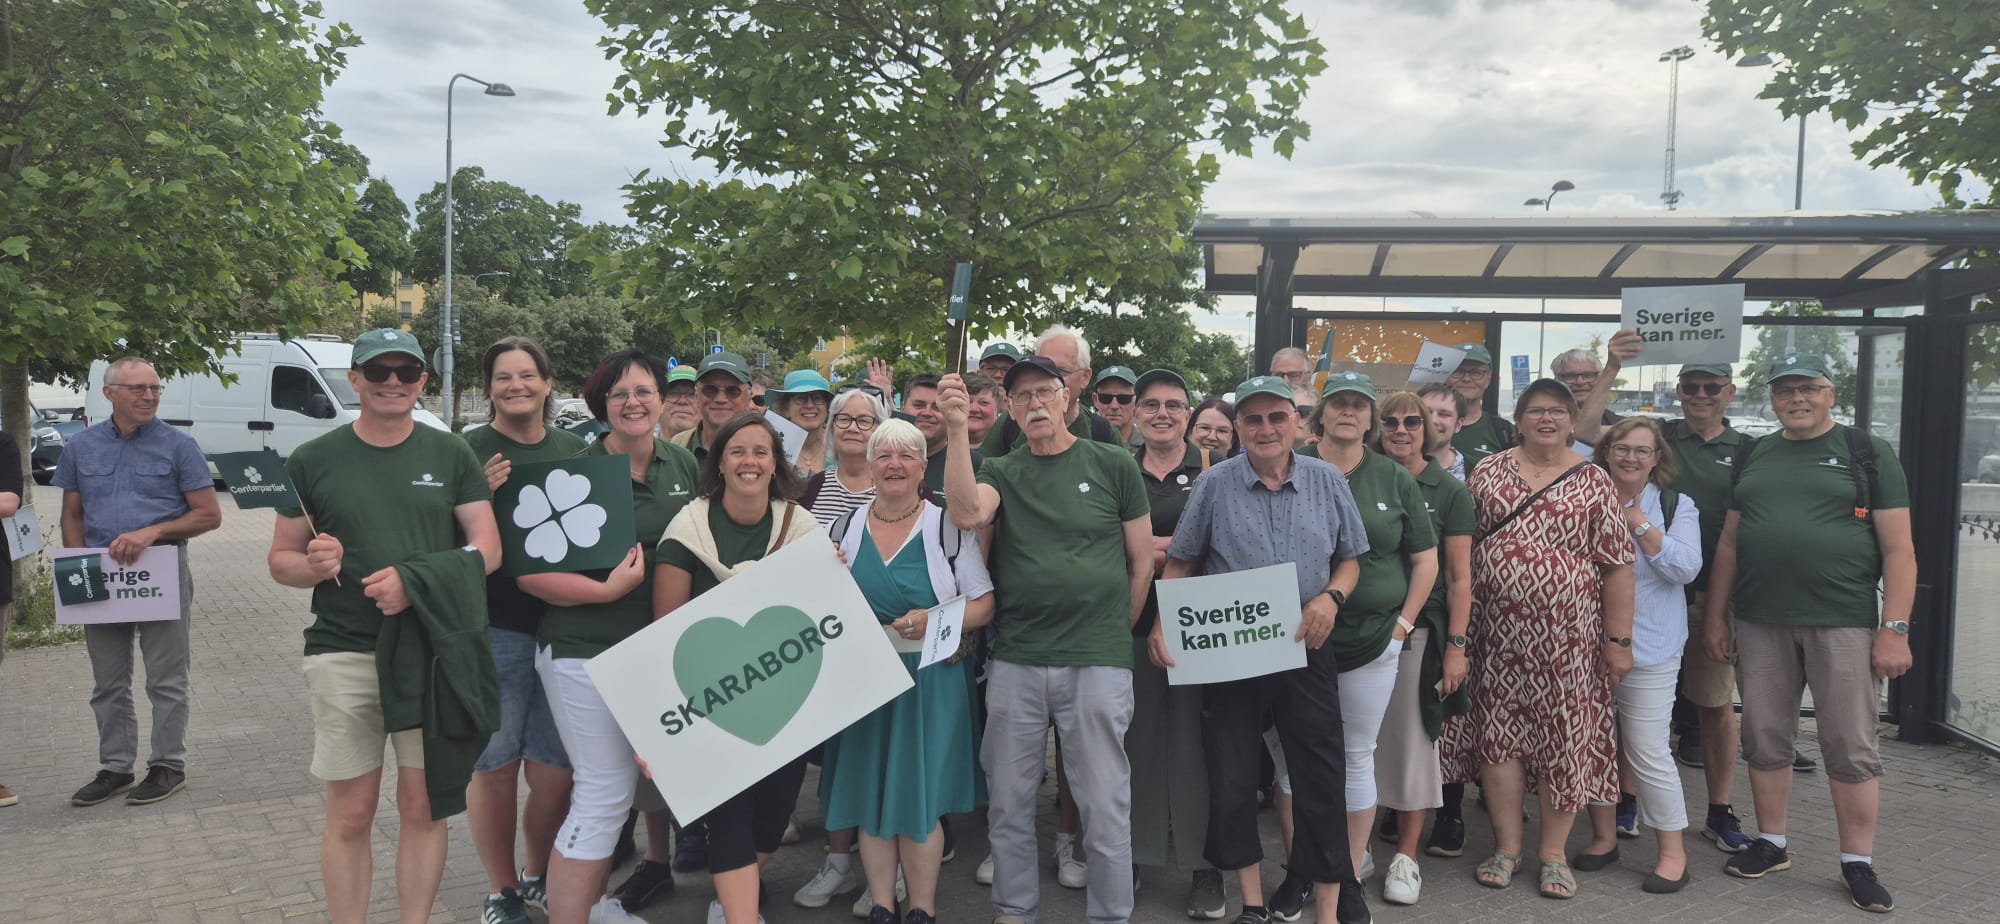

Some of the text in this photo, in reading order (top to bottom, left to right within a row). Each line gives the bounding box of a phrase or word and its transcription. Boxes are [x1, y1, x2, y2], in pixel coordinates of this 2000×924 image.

[1636, 308, 1715, 327] Sverige
[1679, 328, 1726, 341] mer.
[230, 483, 287, 494] Centerpartiet
[81, 558, 94, 599] Centerpartiet
[101, 568, 150, 586] erige
[116, 586, 163, 599] mer.
[1178, 600, 1270, 627] Sverige
[1181, 622, 1286, 651] kan mer.
[660, 614, 844, 736] SKARABORG
